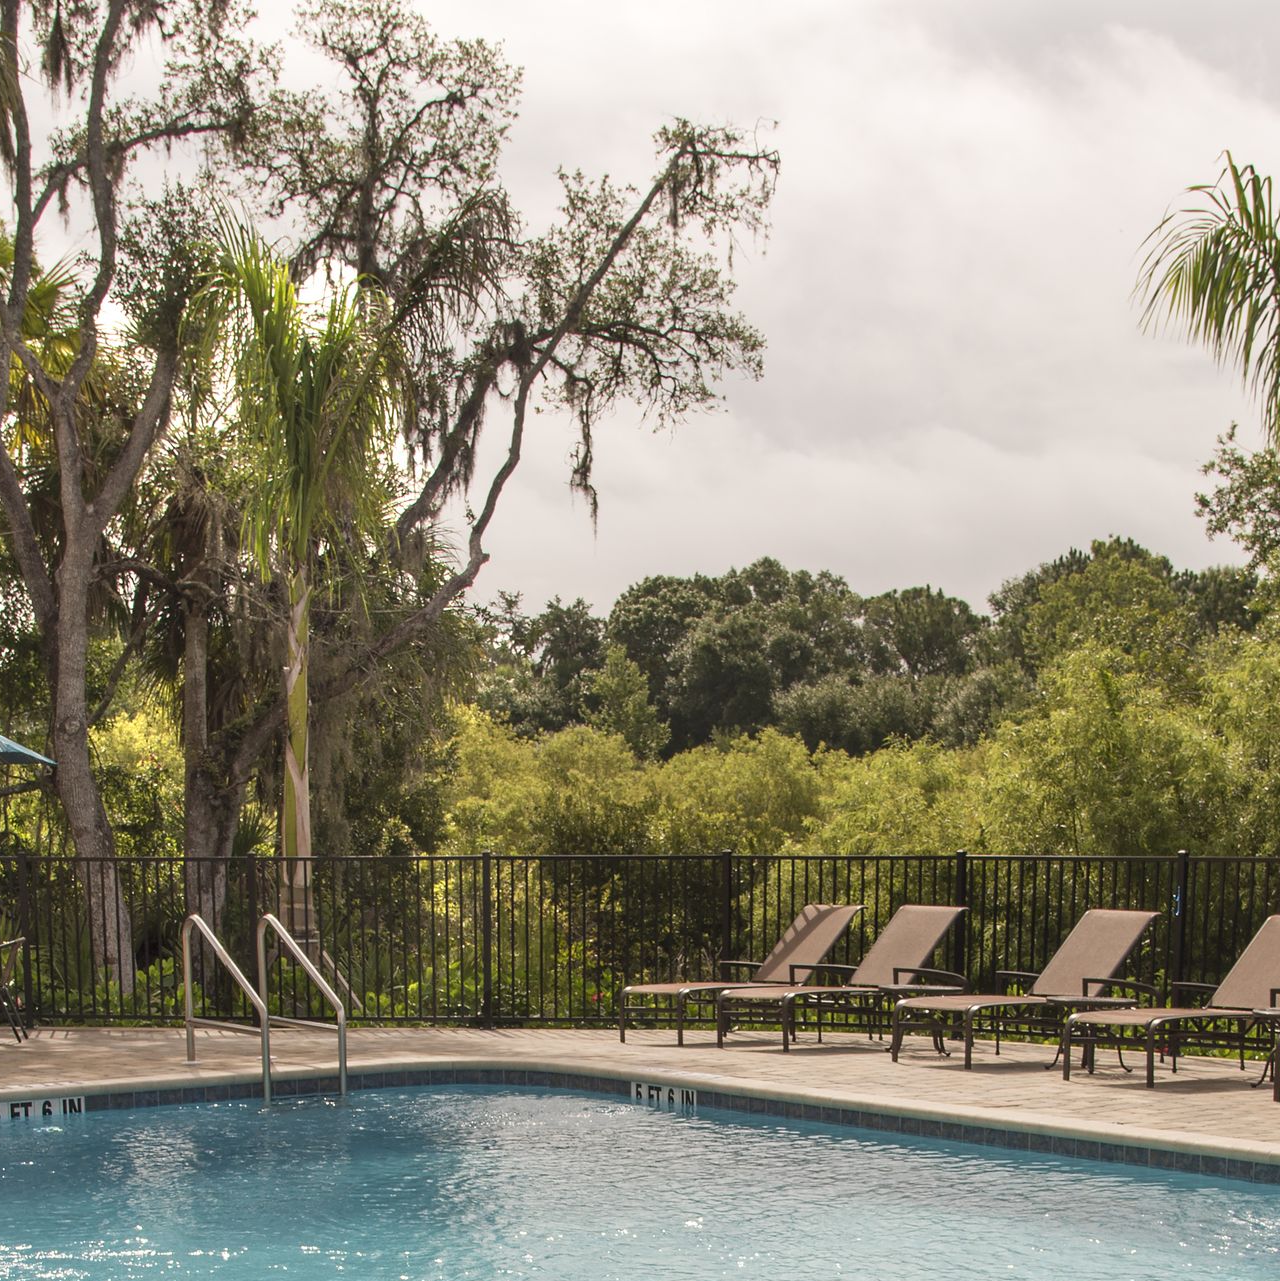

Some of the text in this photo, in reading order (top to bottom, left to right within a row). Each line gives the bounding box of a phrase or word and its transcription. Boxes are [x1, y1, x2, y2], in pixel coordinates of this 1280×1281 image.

[648, 1085, 662, 1101] FT
[668, 1088, 675, 1103] 6
[682, 1090, 695, 1105] IN
[10, 1102, 33, 1118] FT
[42, 1100, 53, 1115] 6
[62, 1098, 82, 1114] IN
